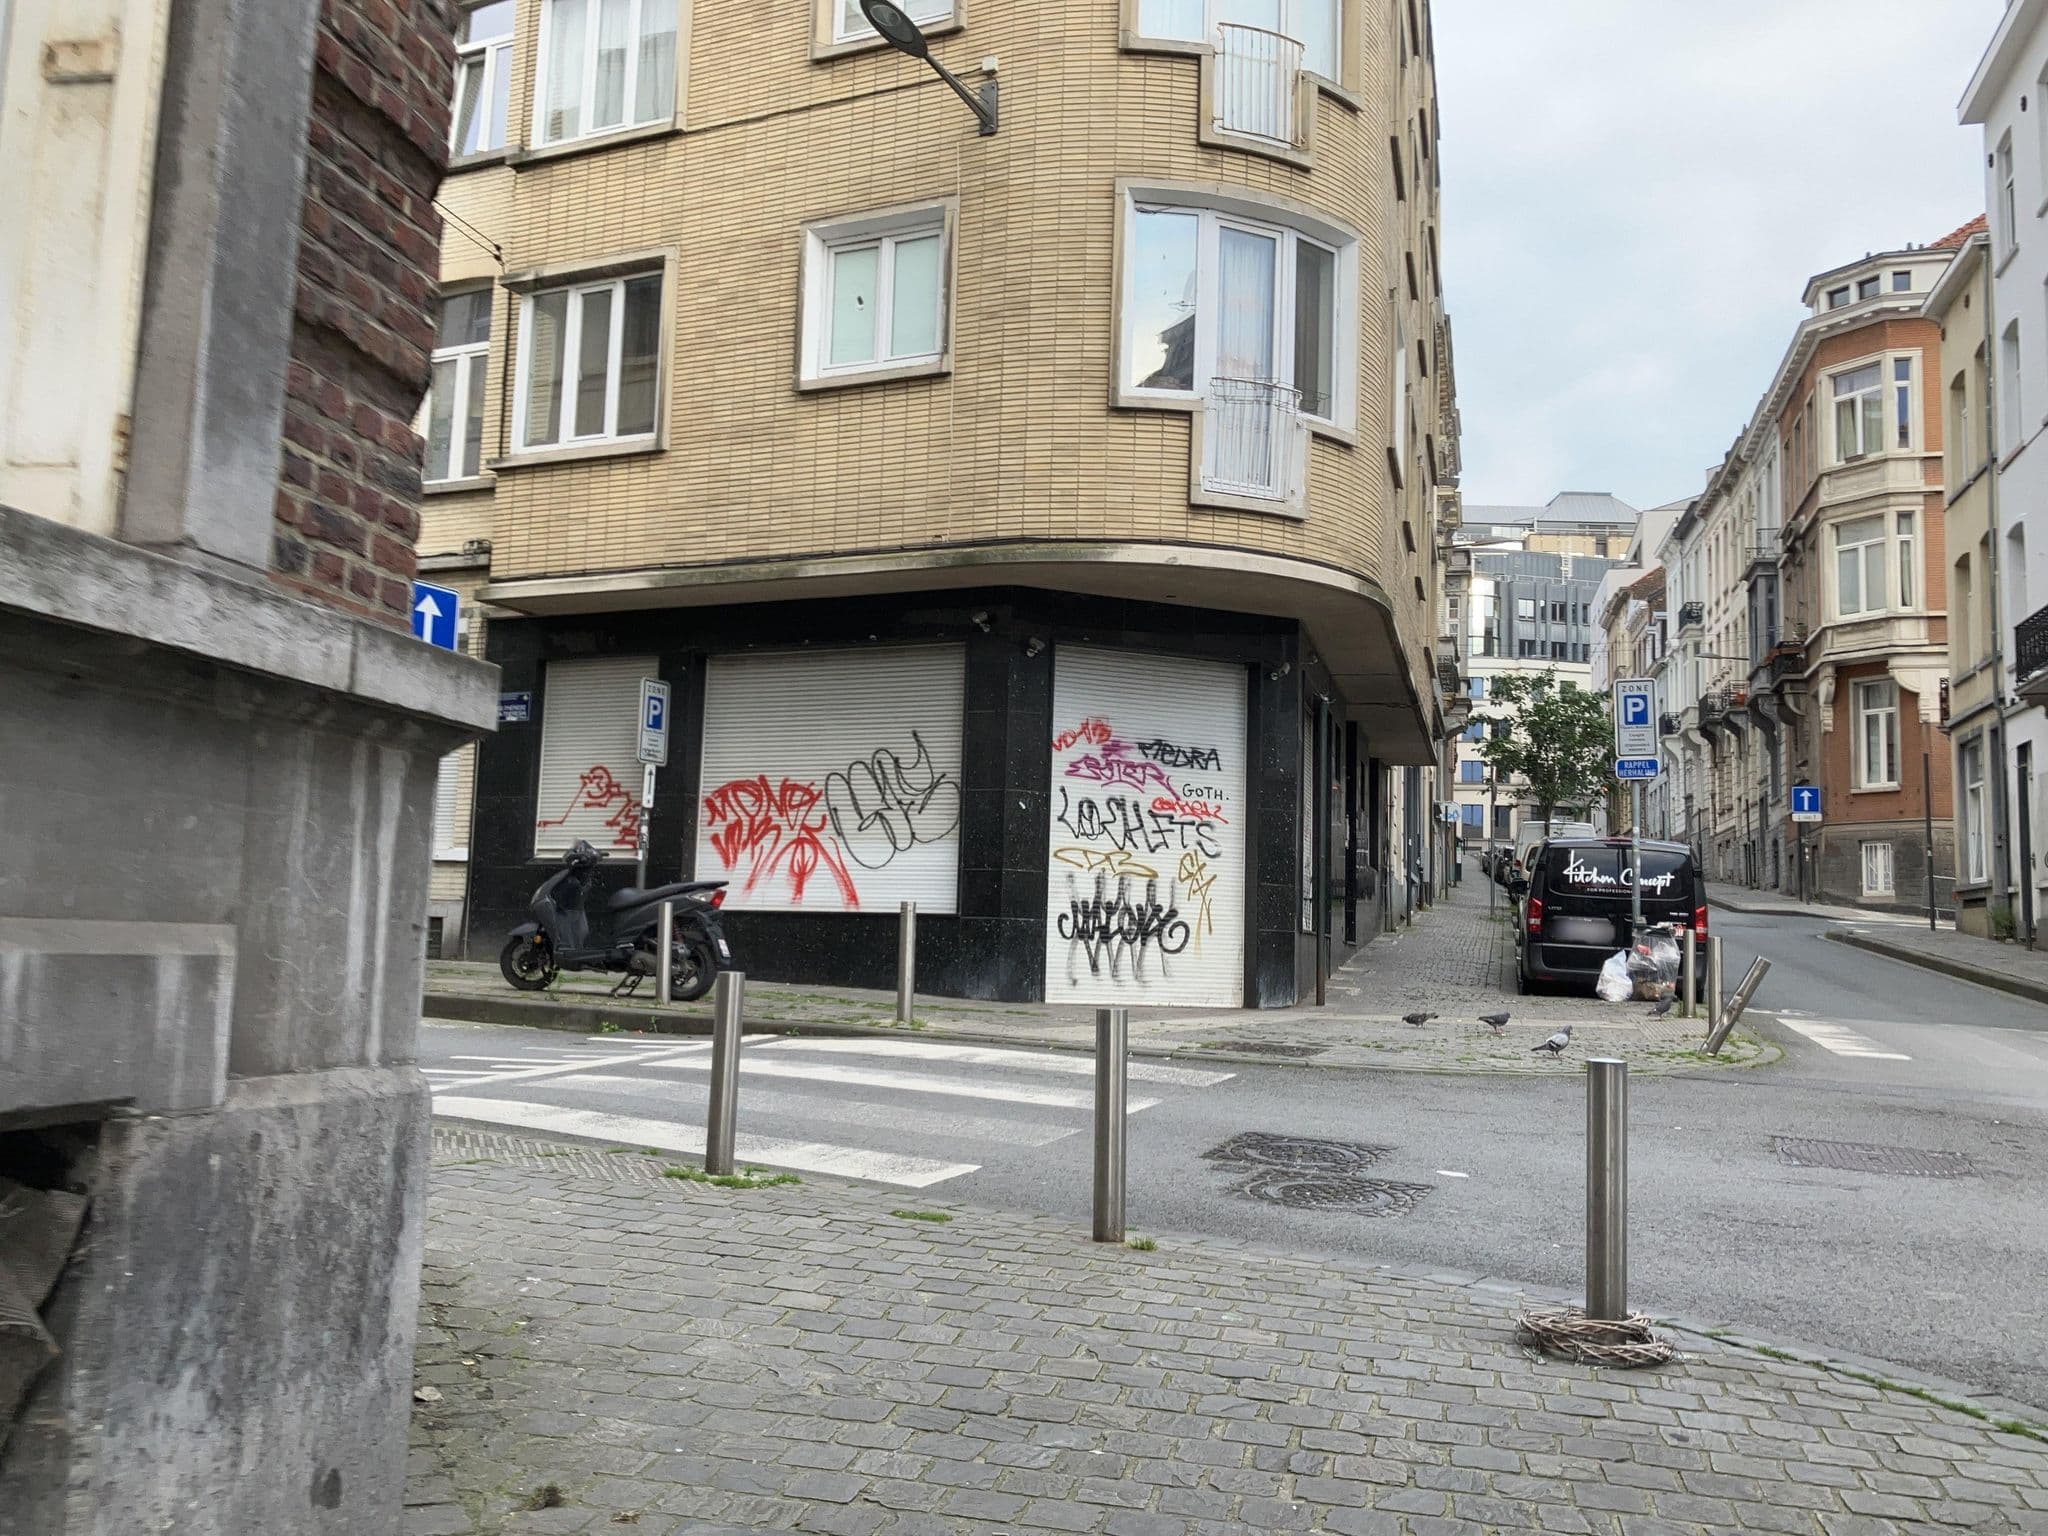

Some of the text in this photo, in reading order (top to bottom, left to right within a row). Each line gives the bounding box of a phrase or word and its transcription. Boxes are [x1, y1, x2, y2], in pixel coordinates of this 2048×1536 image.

[1621, 685, 1649, 693] ZONE
[648, 699, 662, 726] P
[1626, 697, 1645, 723] P
[1624, 761, 1650, 769] RAPPEL
[1562, 849, 1675, 895] Kitchen Cncept
